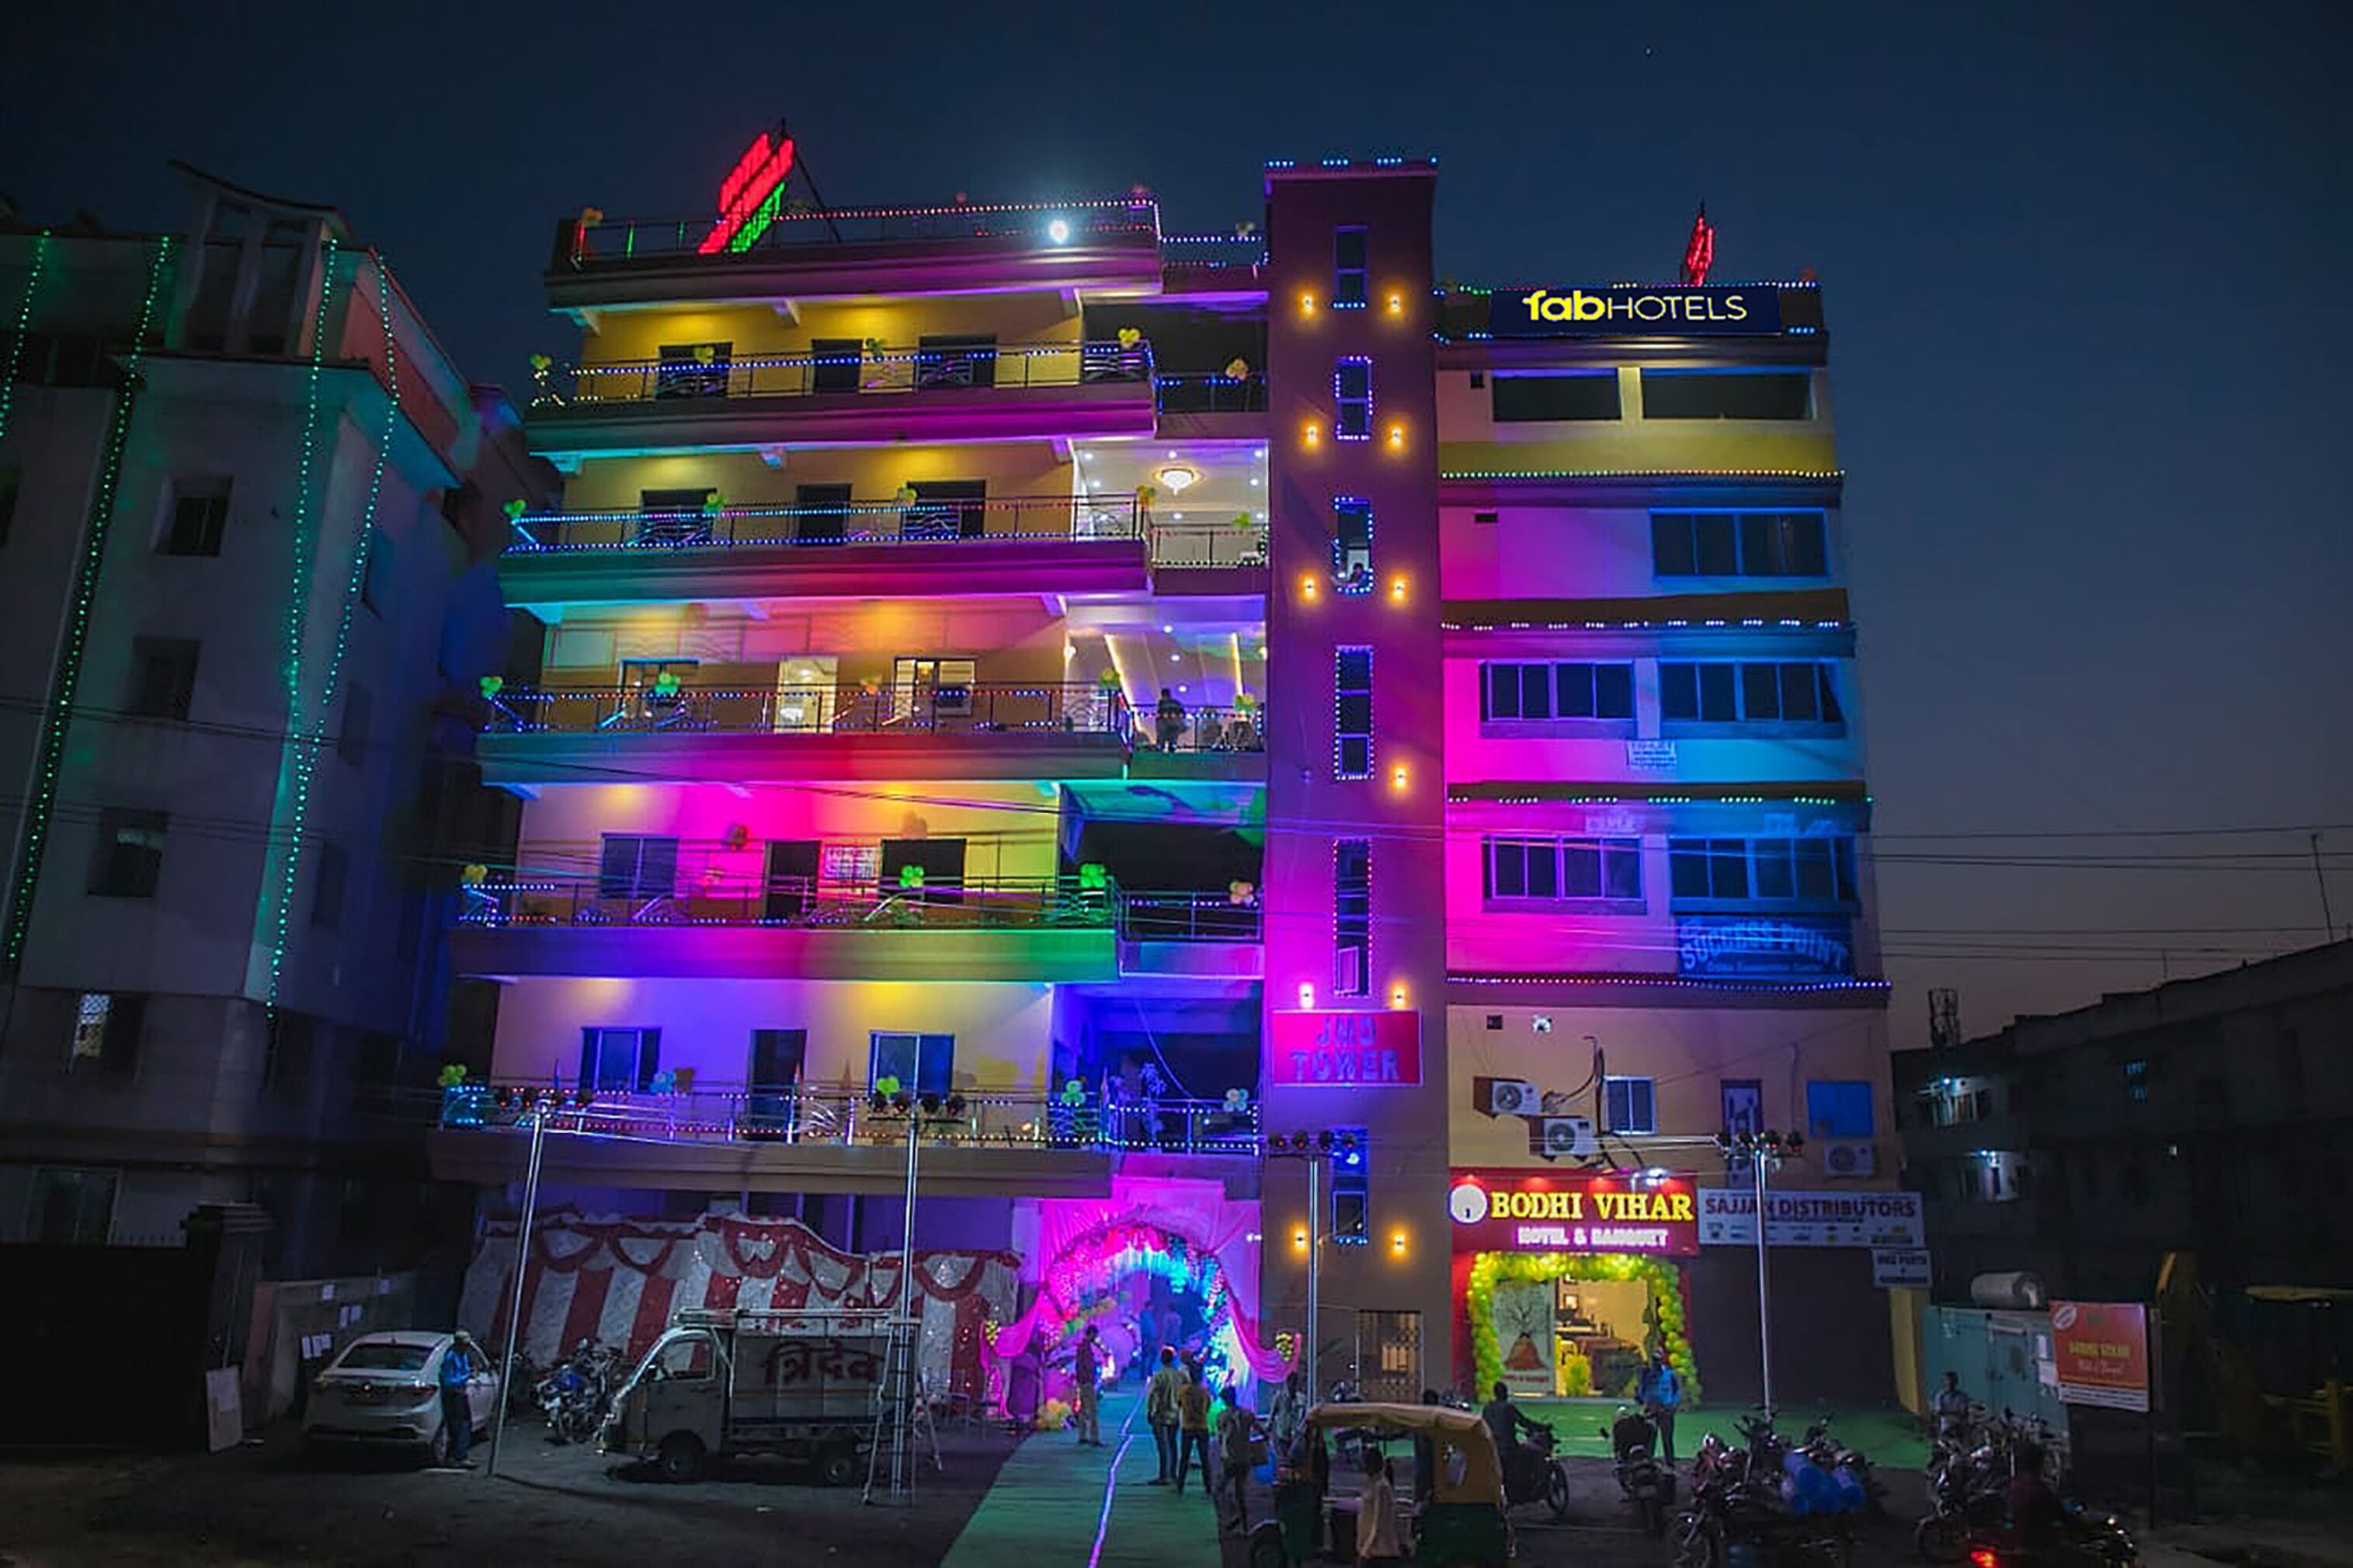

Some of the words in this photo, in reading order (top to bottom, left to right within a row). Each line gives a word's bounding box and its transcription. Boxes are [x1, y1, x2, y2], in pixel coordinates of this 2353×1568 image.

[1781, 923, 1849, 969] POINT
[1291, 1050, 1400, 1080] TOWER
[1490, 1192, 1583, 1220] BODHI
[1594, 1193, 1694, 1222] VIHAR
[1779, 1199, 1916, 1218] DISTRIBUTORS
[1517, 1227, 1569, 1245] HOTEL
[1573, 1228, 1587, 1246] &
